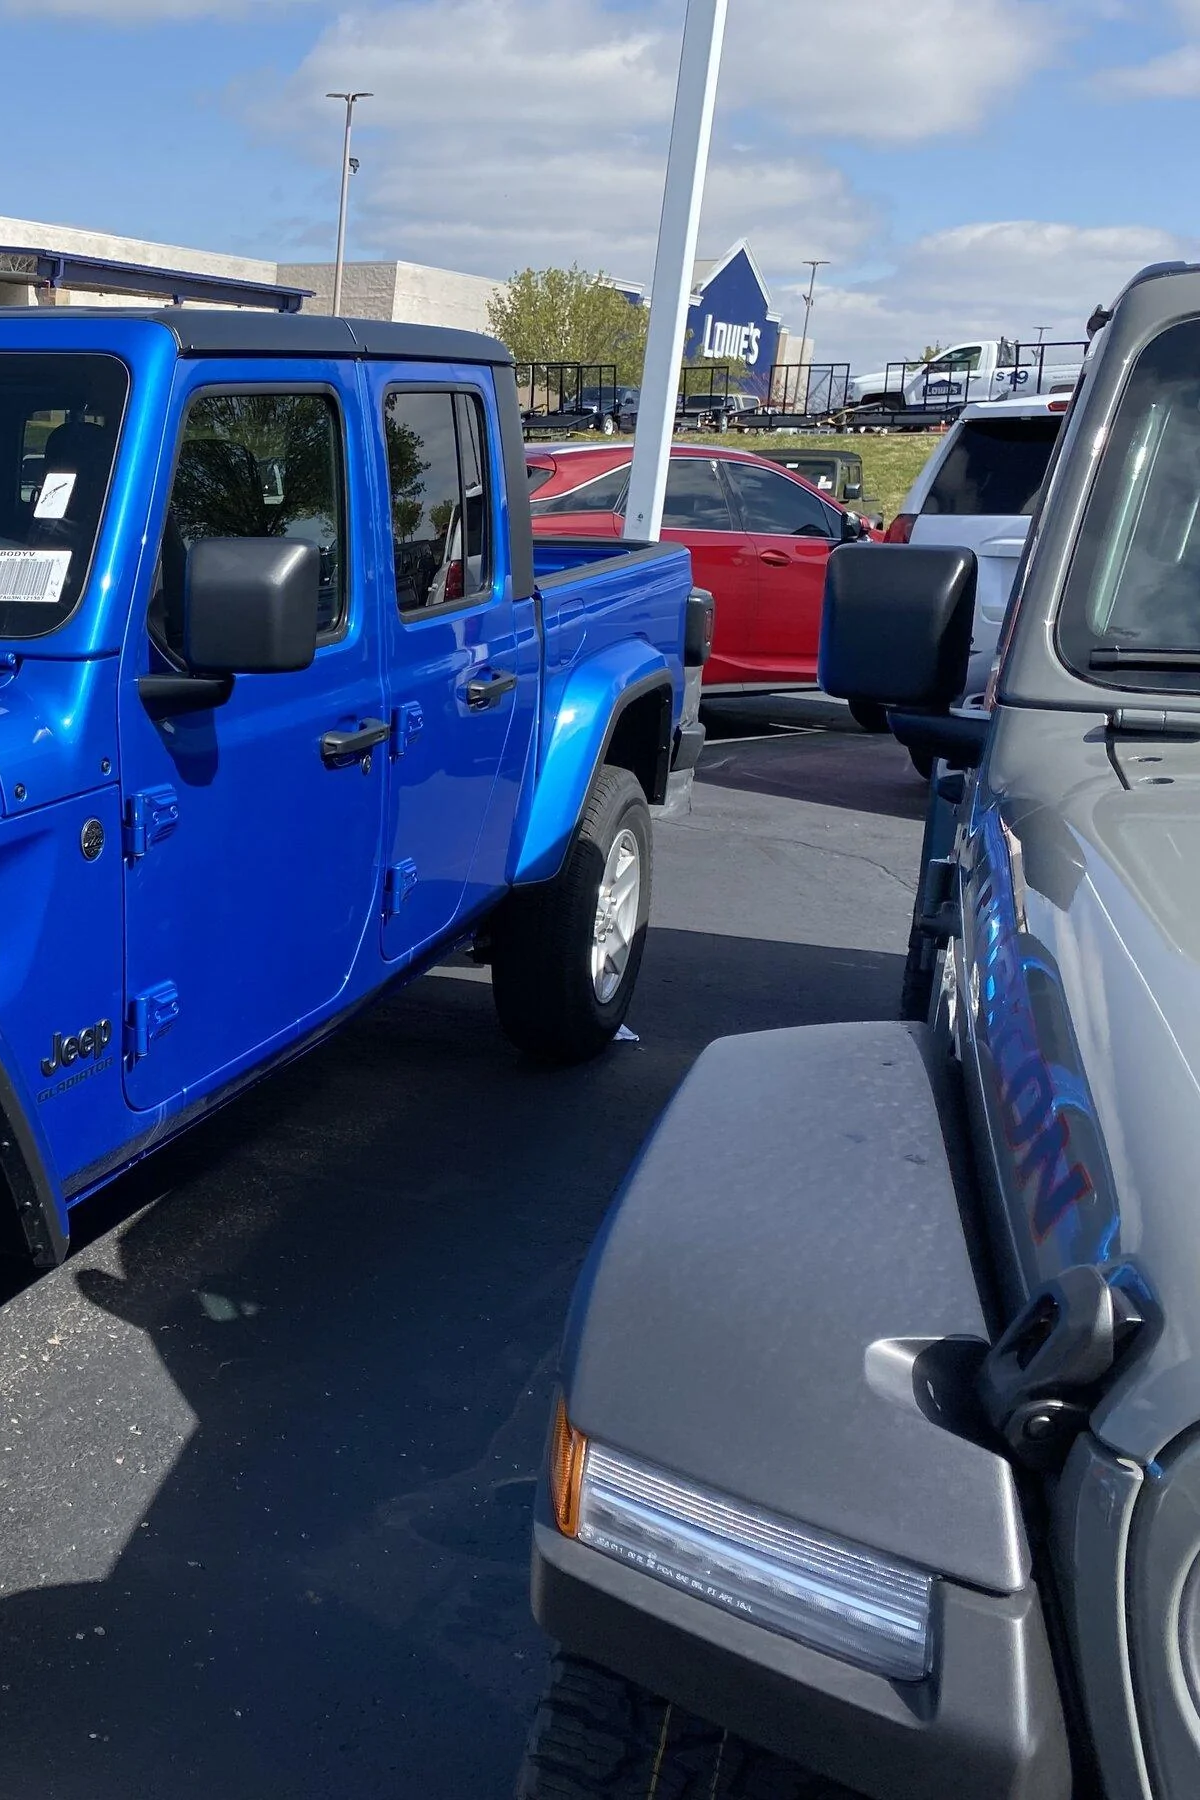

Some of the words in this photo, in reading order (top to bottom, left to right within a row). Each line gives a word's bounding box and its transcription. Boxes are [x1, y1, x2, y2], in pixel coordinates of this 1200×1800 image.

[703, 314, 761, 365] LOWE'S
[41, 1018, 112, 1077] Jeep
[36, 1056, 113, 1105] GLADIATOR
